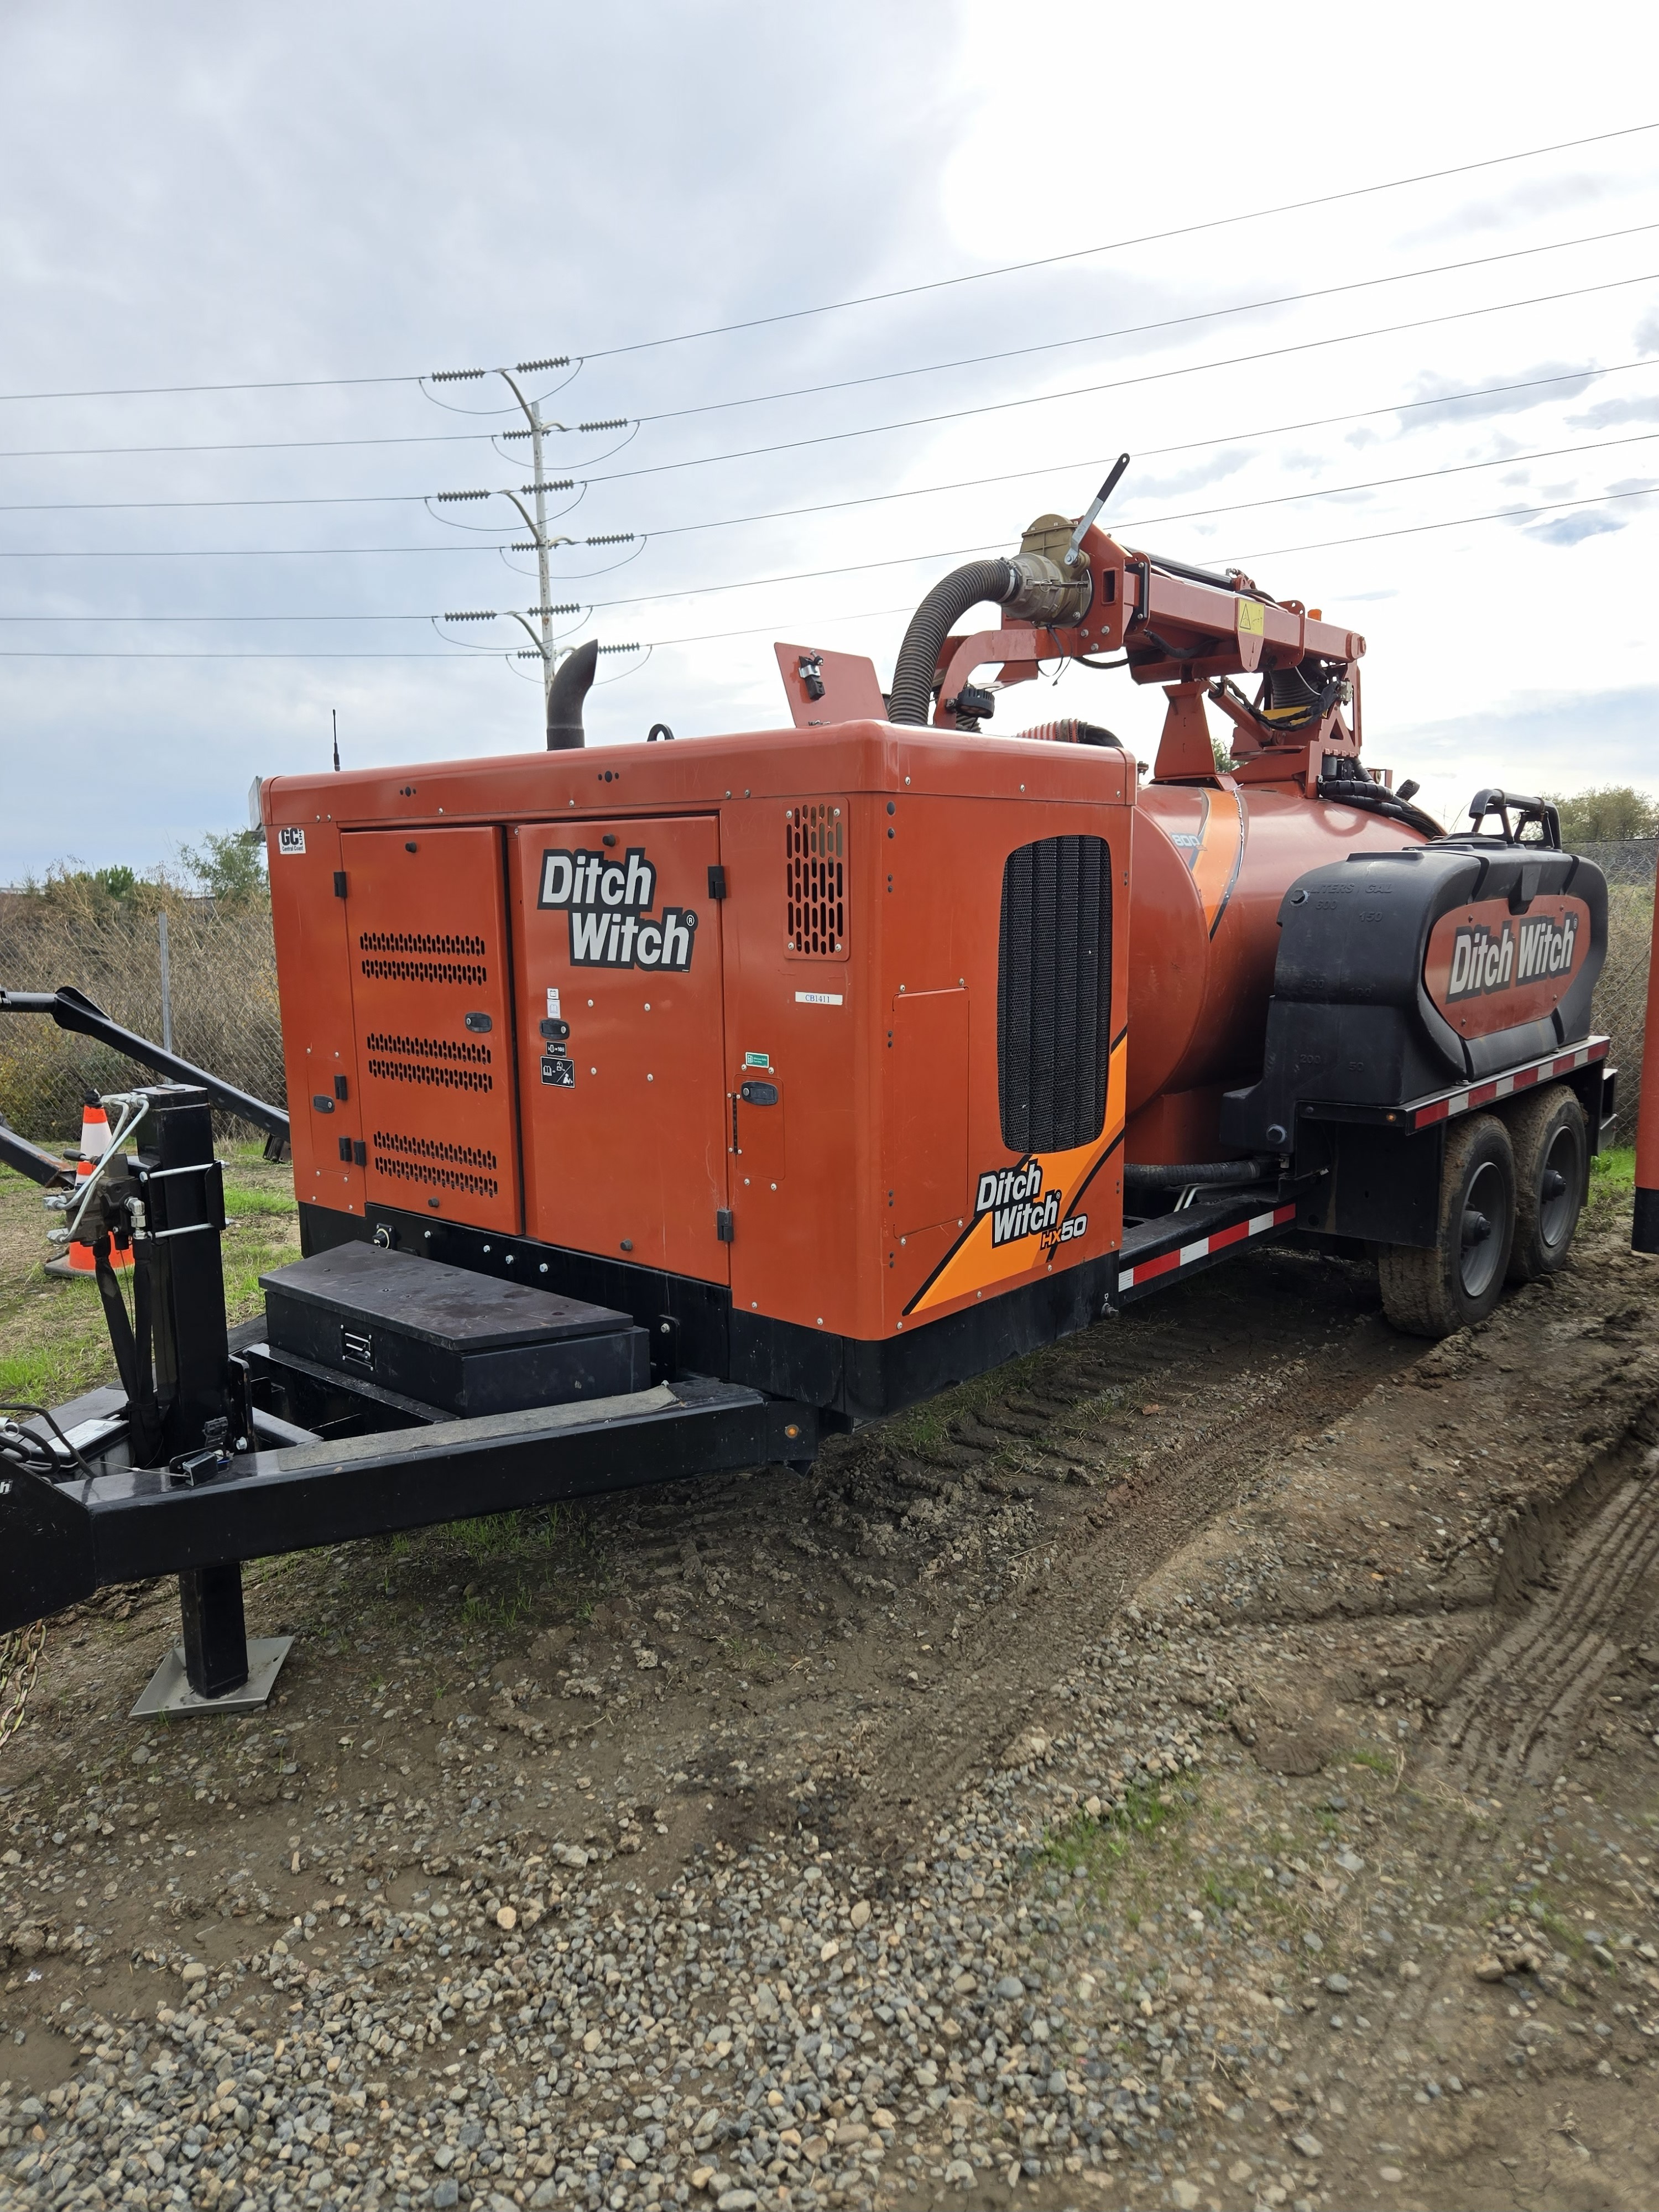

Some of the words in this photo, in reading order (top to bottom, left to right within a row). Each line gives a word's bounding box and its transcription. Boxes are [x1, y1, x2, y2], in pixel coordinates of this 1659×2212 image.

[281, 828, 299, 846] GC
[1171, 834, 1201, 846] 800
[542, 855, 651, 905] Ditch
[1365, 884, 1392, 894] GAL
[1316, 900, 1337, 910] 600
[1359, 912, 1383, 922] 150
[1449, 928, 1514, 995] Ditch
[805, 994, 830, 1003] CB1411
[977, 1164, 1041, 1211] Ditch
[1041, 1215, 1087, 1248] HX50
